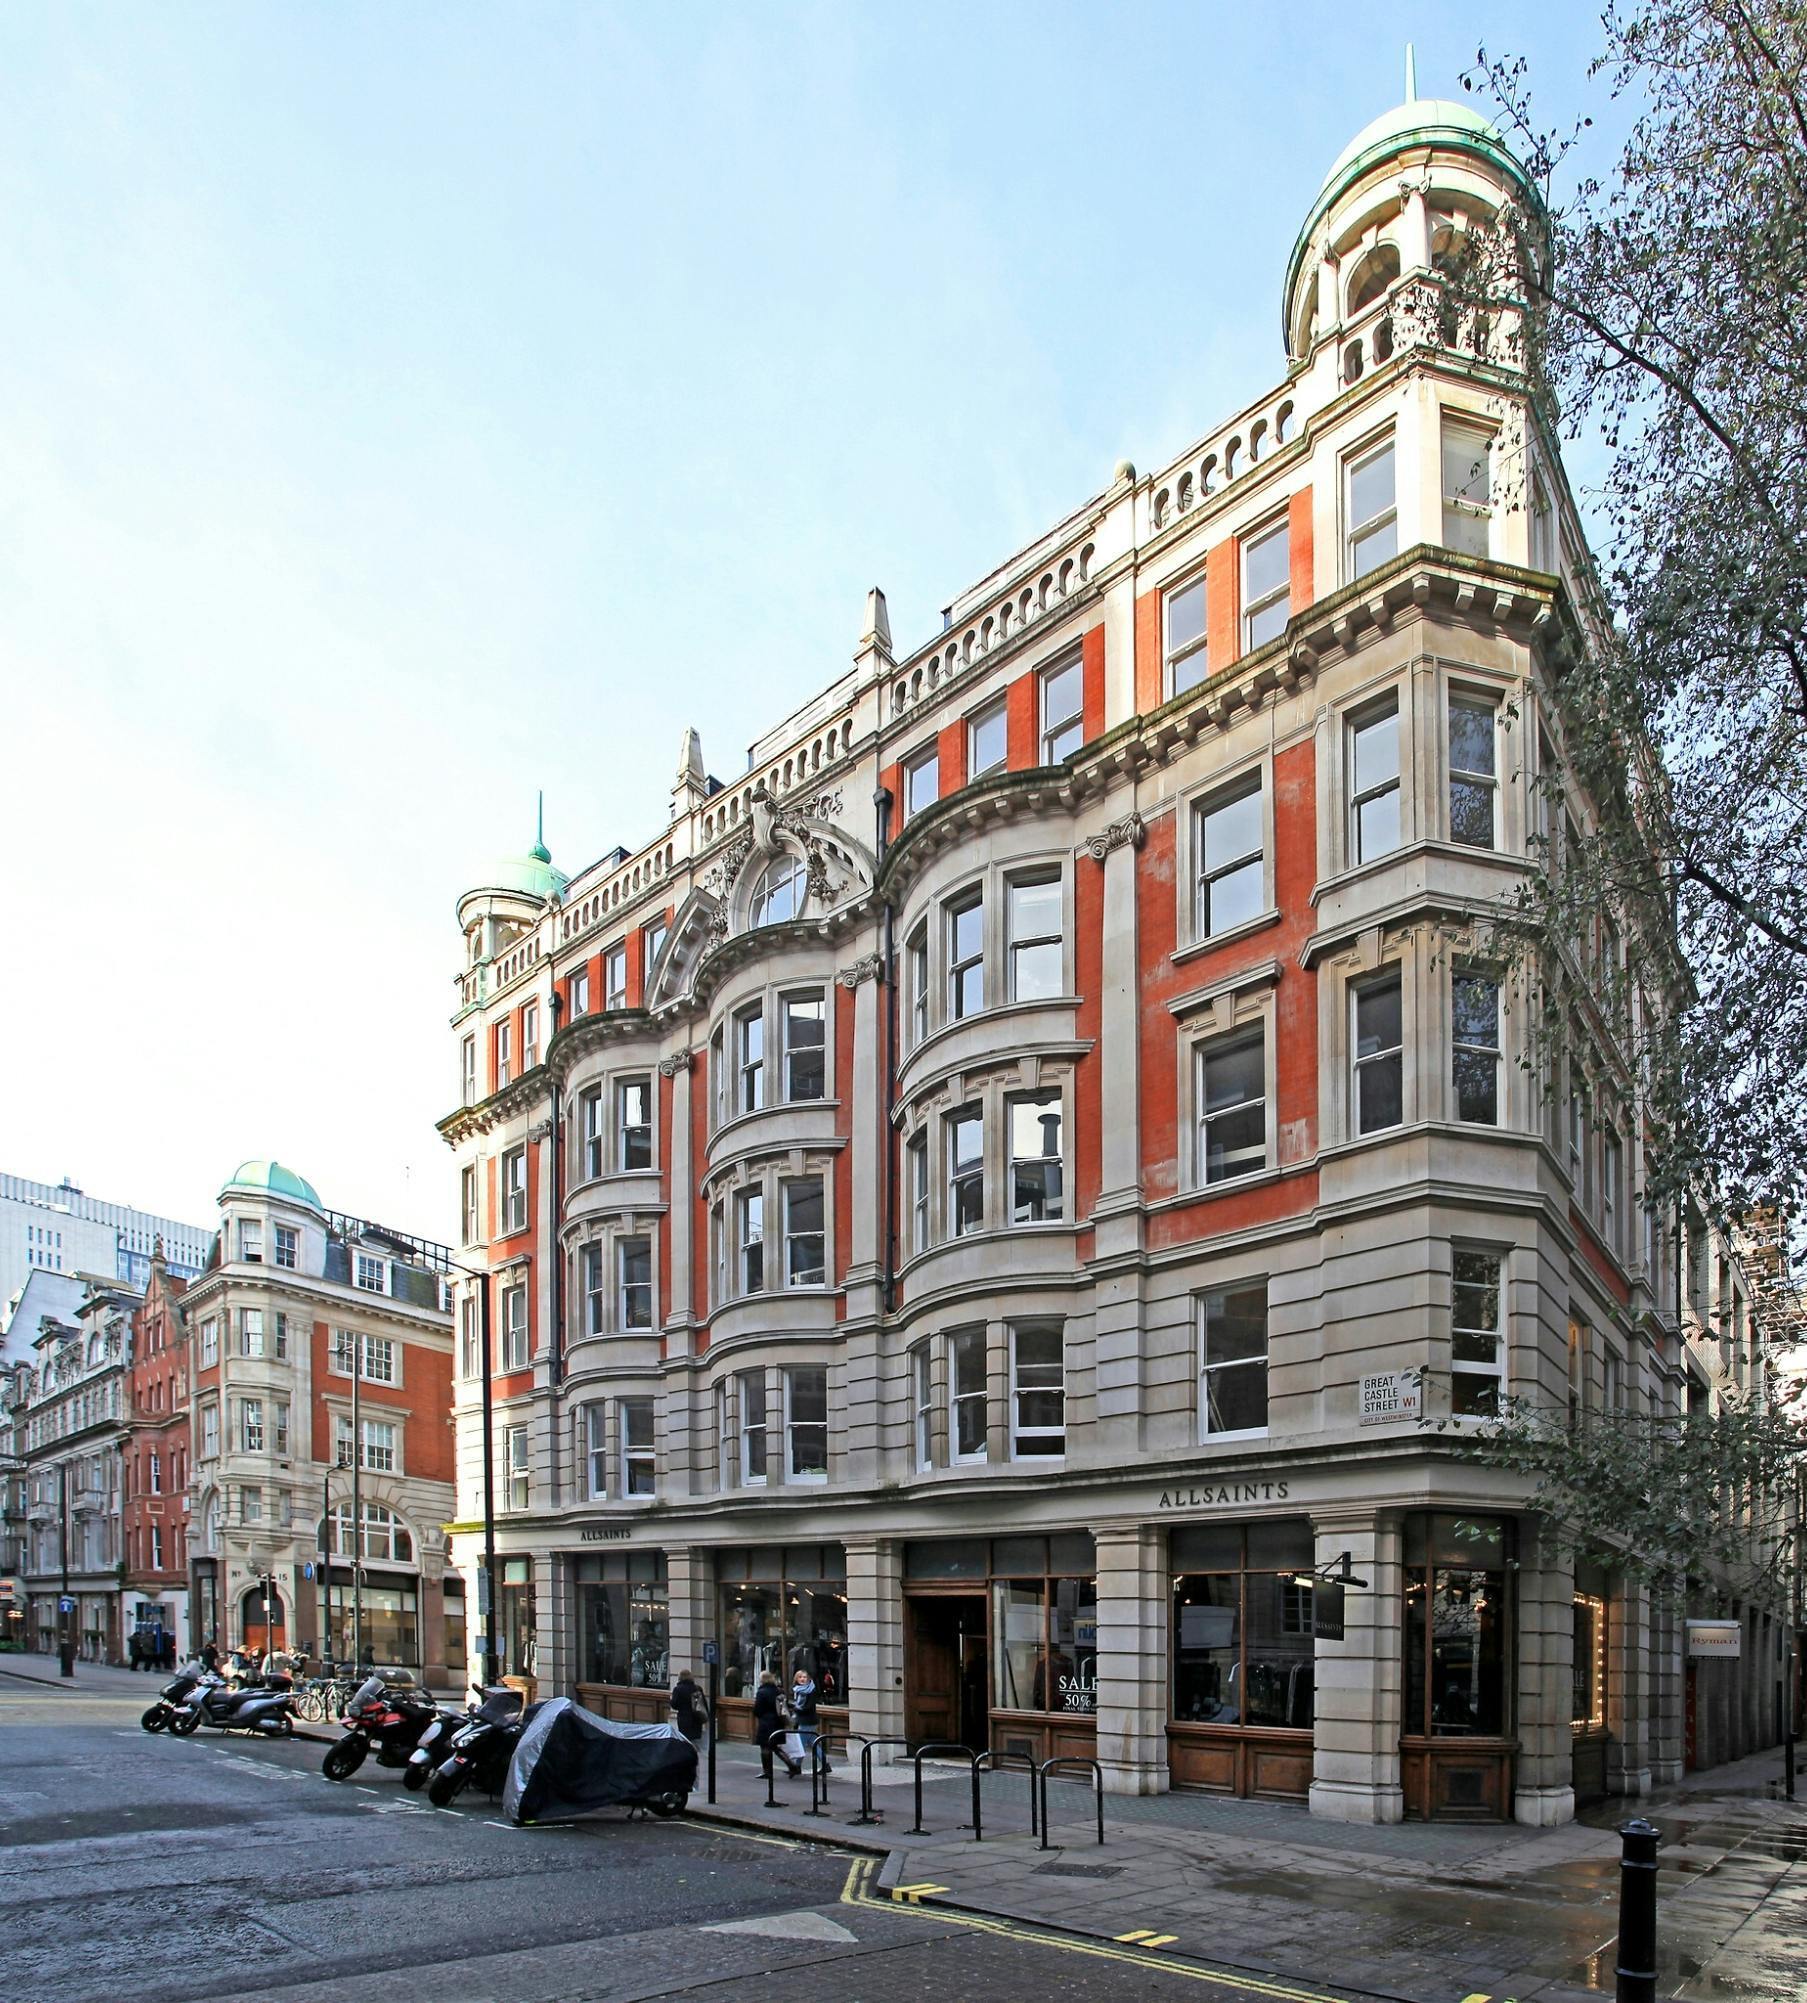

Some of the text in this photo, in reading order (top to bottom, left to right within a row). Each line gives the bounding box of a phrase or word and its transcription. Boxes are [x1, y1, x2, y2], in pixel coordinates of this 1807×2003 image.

[1364, 1376, 1394, 1389] GREAT
[1364, 1388, 1398, 1401] CASTLE
[1364, 1397, 1415, 1413] STREET W1
[1159, 1482, 1288, 1508] ALLSAINTS
[581, 1528, 631, 1541] ALLSAINTS
[1692, 1637, 1737, 1645] Ryman
[706, 1645, 716, 1661] P
[644, 1660, 667, 1672] SALE
[1059, 1676, 1099, 1691] SALE
[1065, 1694, 1091, 1707] 50%
